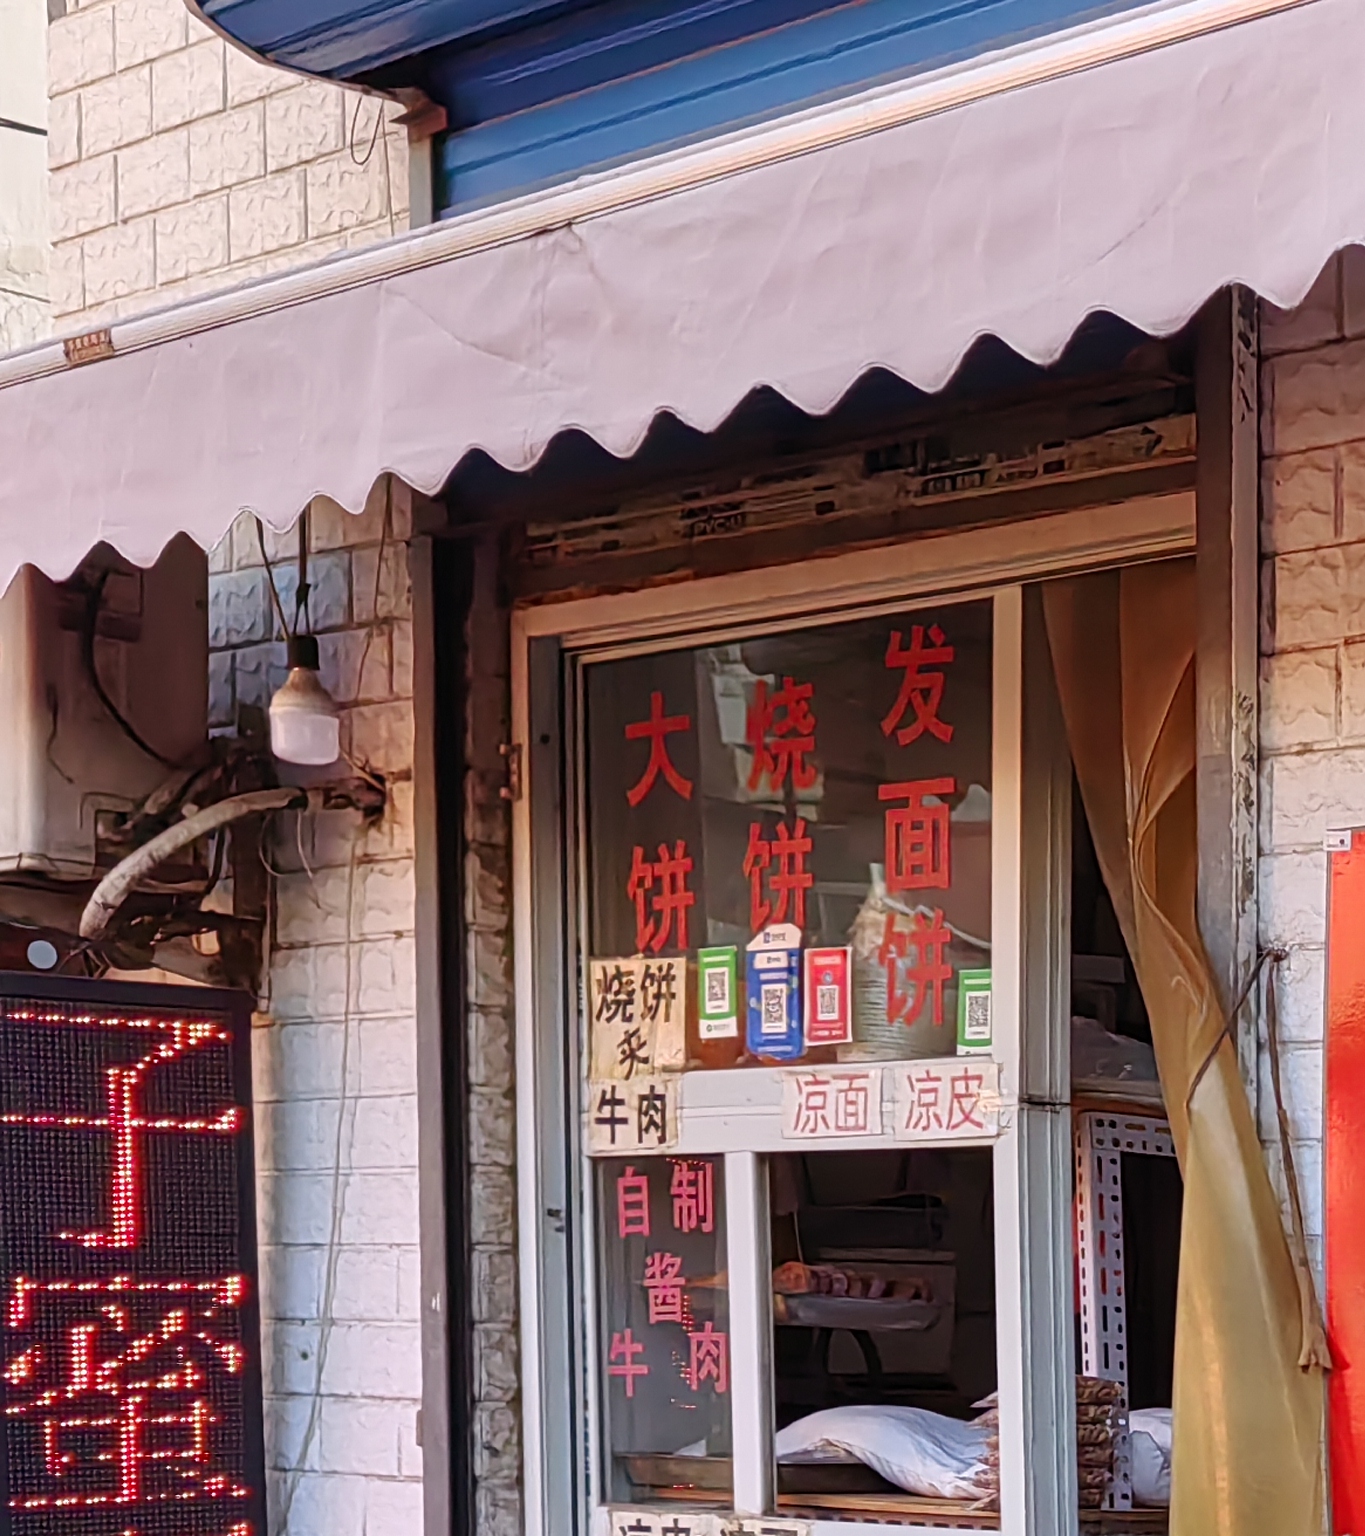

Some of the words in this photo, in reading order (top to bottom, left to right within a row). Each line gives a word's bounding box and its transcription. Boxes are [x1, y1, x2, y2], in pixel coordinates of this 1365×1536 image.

[624, 692, 694, 953] 大饼
[744, 677, 817, 930] 烧饼
[878, 624, 955, 1027] 发面饼
[596, 962, 676, 1024] 烧饼
[595, 1085, 667, 1145] 牛肉
[793, 1072, 870, 1135] 凉面
[904, 1067, 987, 1133] 凉皮
[617, 1162, 715, 1239] 自制
[643, 1252, 686, 1325] 酱
[607, 1321, 729, 1398] 牛肉
